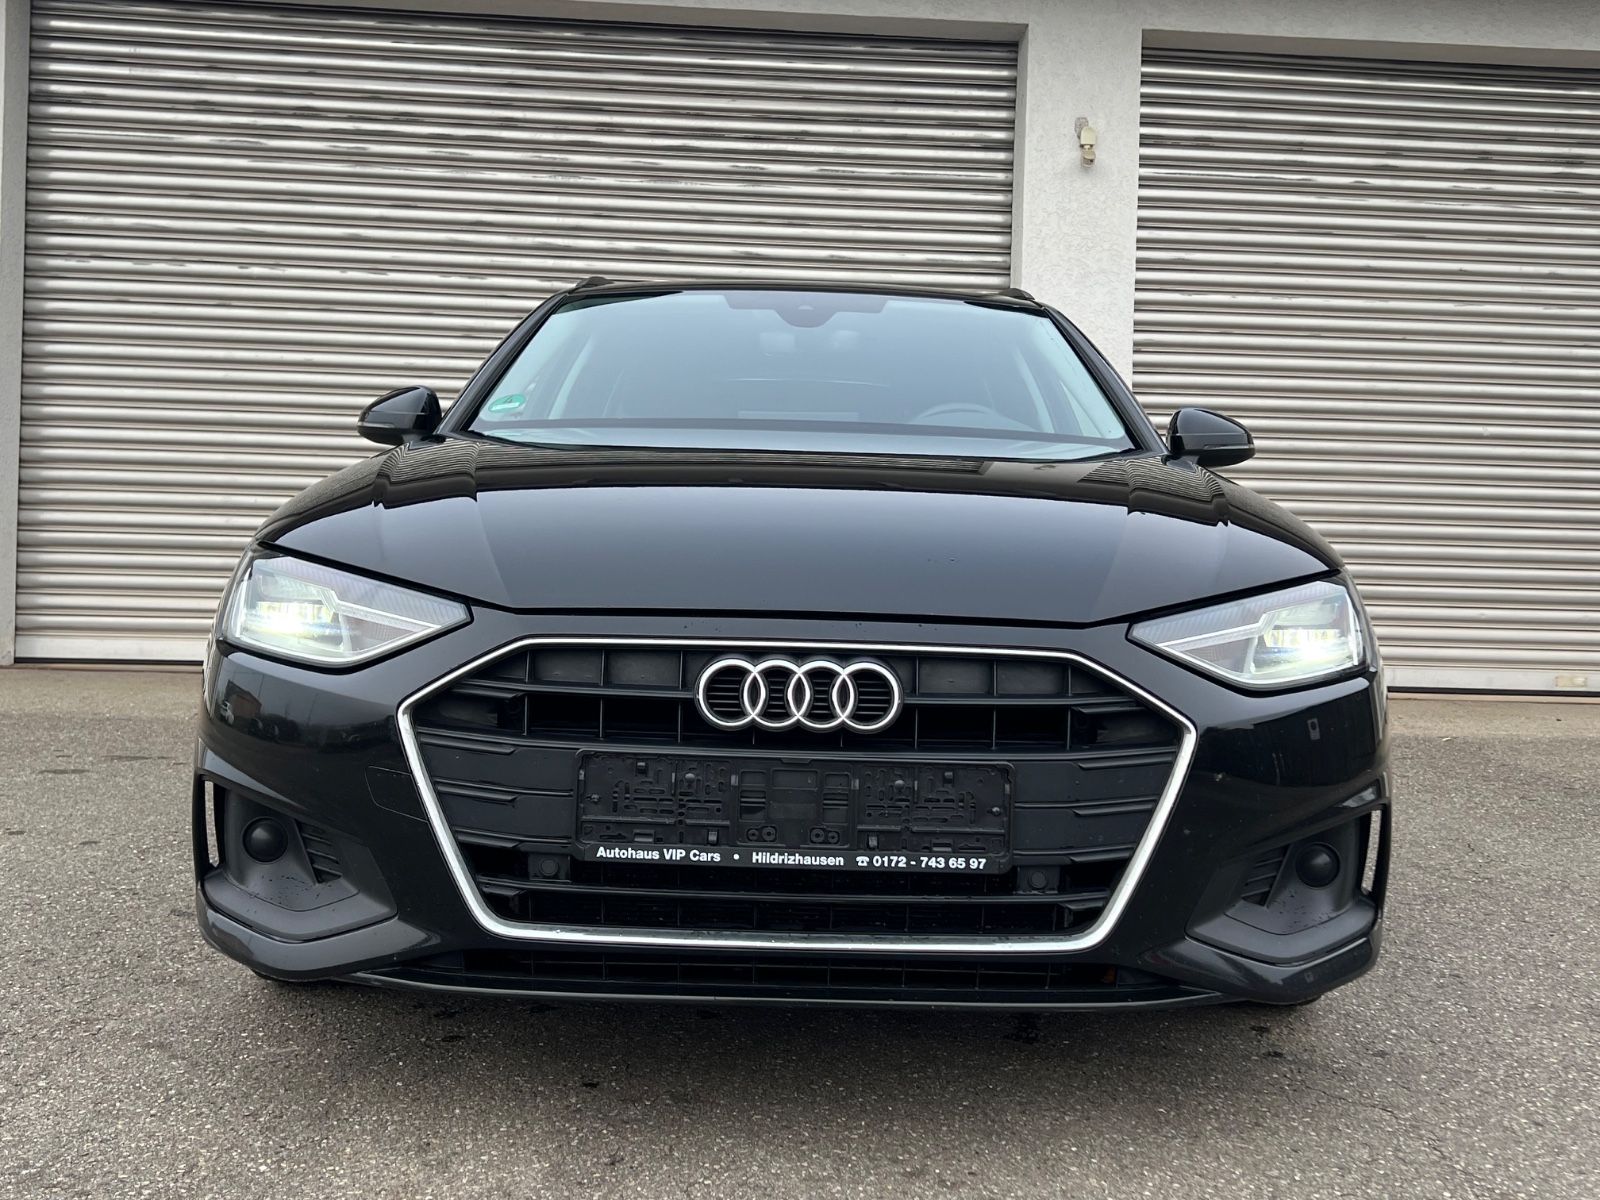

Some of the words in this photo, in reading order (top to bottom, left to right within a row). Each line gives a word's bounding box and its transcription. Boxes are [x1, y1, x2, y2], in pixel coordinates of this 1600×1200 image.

[596, 846, 660, 860] Autohaus
[662, 848, 686, 861] VIP
[689, 849, 721, 862] Cars
[752, 851, 845, 866] Hildrizhausen
[872, 855, 907, 868] 0172
[919, 856, 946, 869] 743
[948, 857, 966, 870] 65
[969, 857, 987, 871] 97
